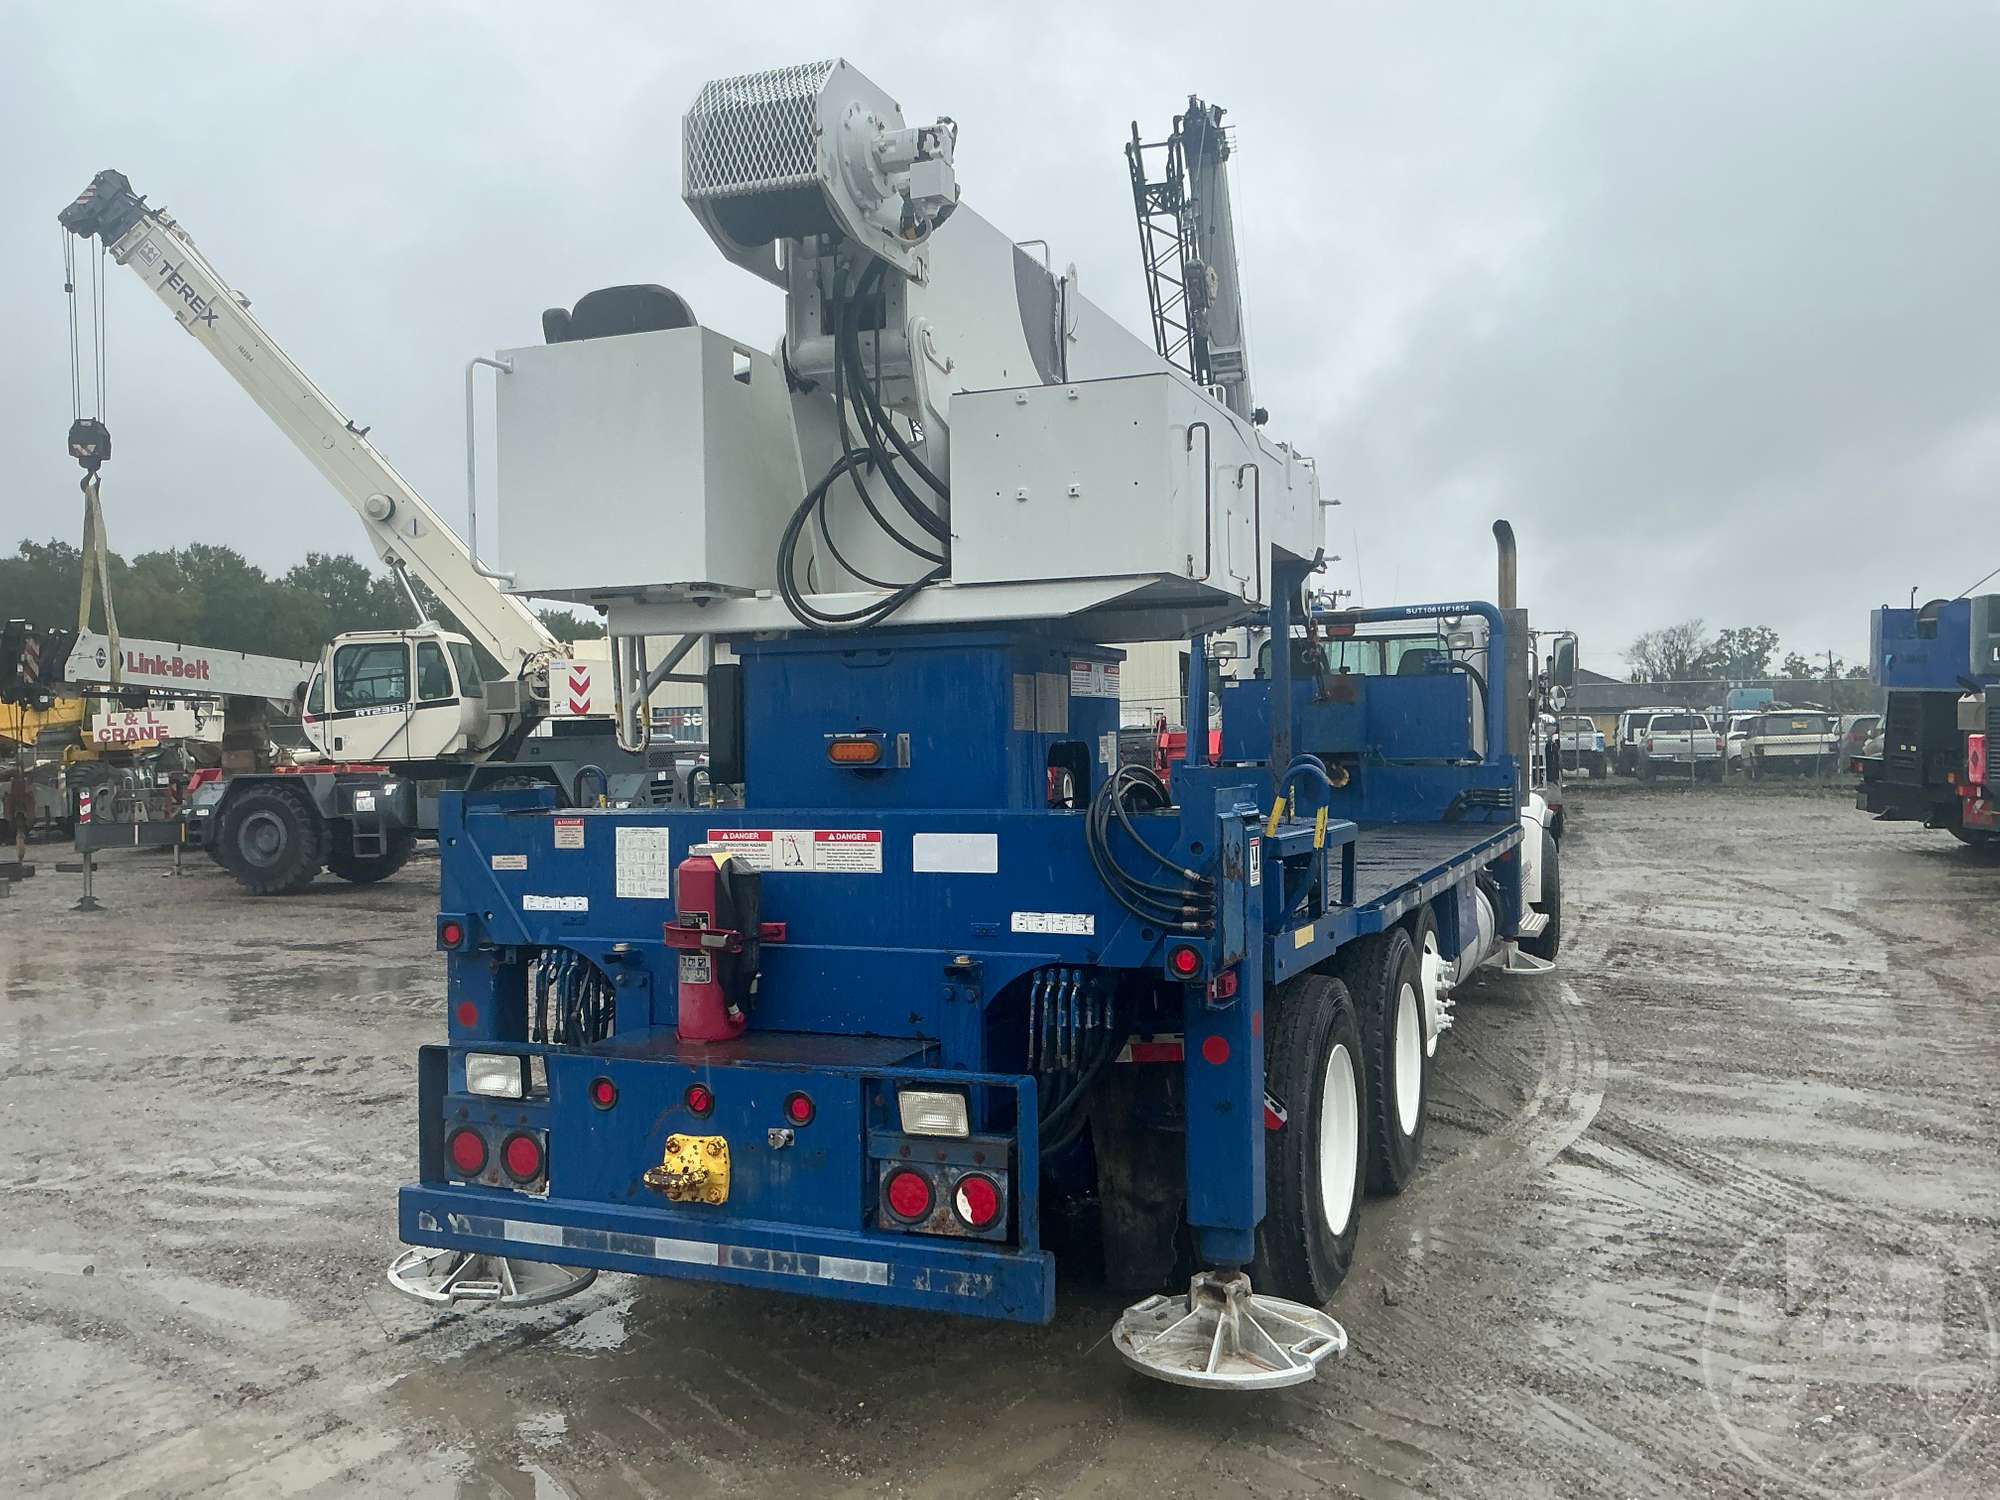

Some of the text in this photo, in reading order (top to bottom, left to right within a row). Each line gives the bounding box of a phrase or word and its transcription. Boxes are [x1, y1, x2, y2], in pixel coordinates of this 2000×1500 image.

[159, 259, 219, 329] TEREX
[127, 651, 210, 680] Link-Belt
[107, 711, 160, 727] L & L
[99, 726, 170, 741] CRANE
[729, 831, 760, 840] DANGER
[835, 833, 867, 841] DANGER
